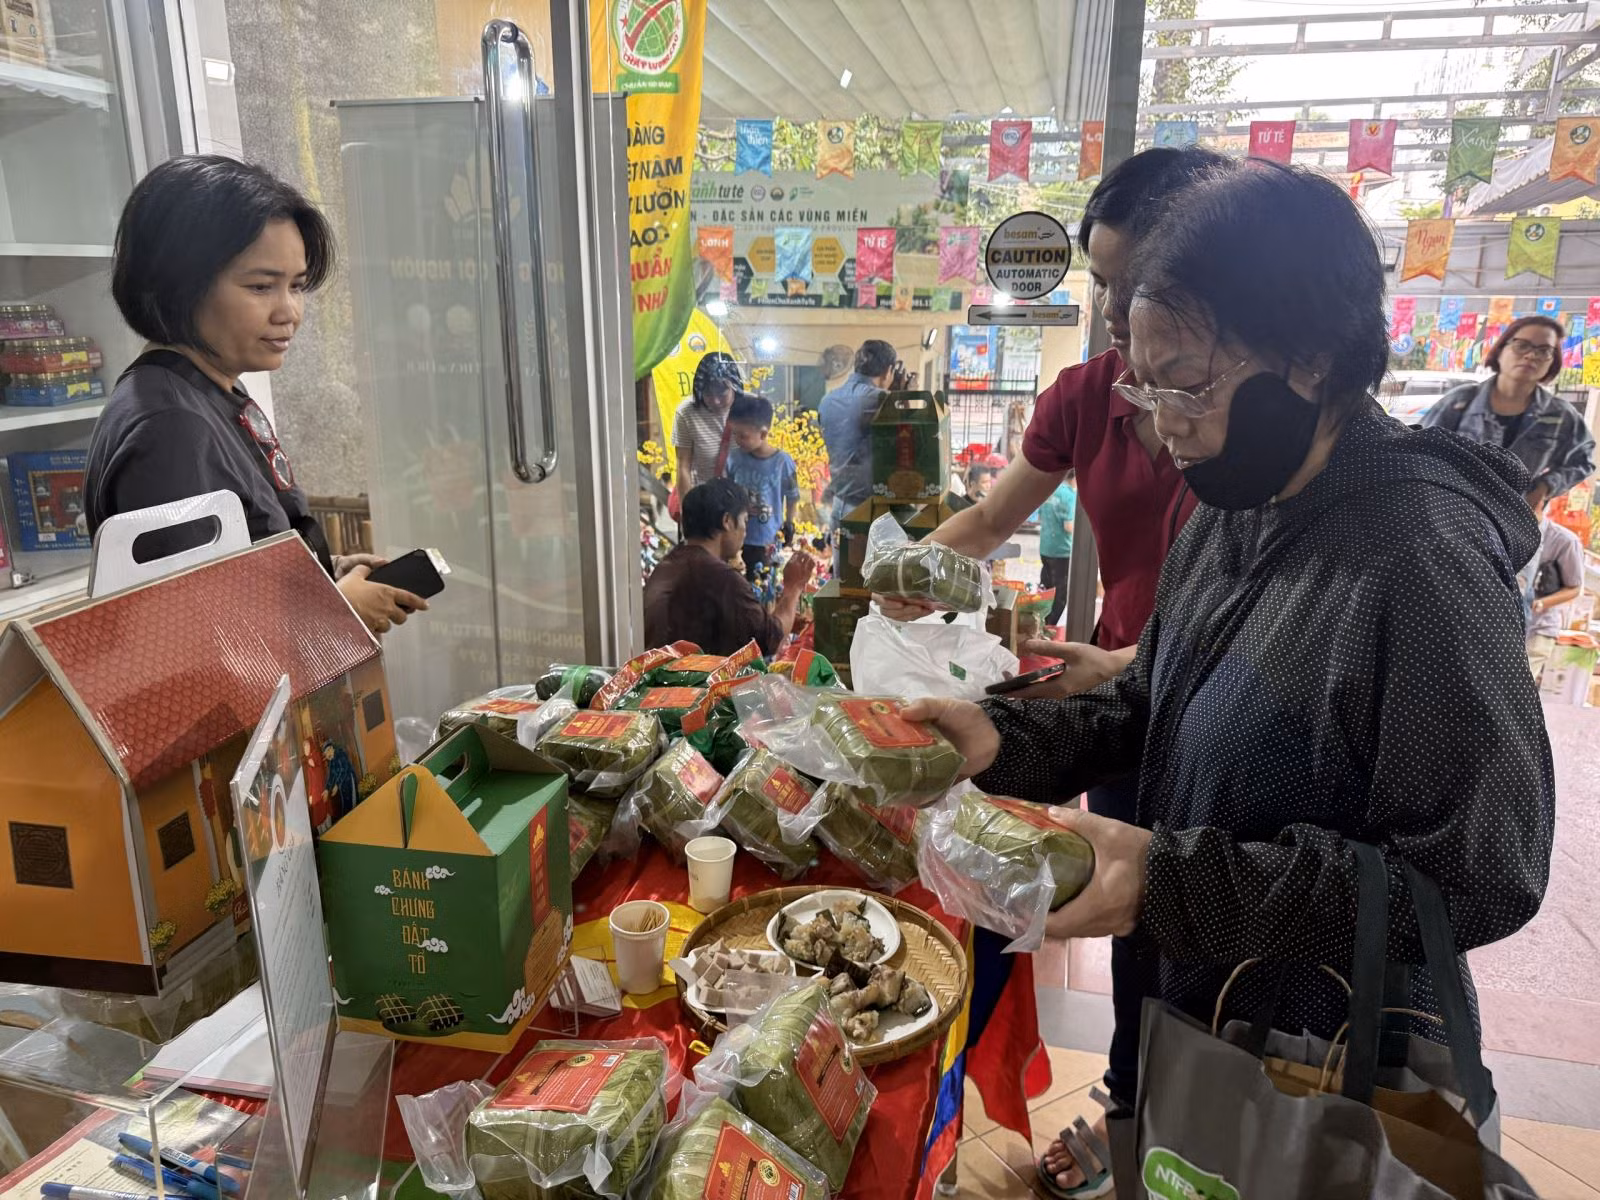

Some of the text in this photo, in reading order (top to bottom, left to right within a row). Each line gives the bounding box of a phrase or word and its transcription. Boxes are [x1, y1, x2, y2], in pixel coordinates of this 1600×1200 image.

[990, 249, 1066, 263] CAUTION
[996, 268, 1060, 279] AUTOMATIC
[1011, 281, 1042, 292] DOOR
[392, 867, 430, 890] BÁNH
[408, 949, 426, 974] TỔ
